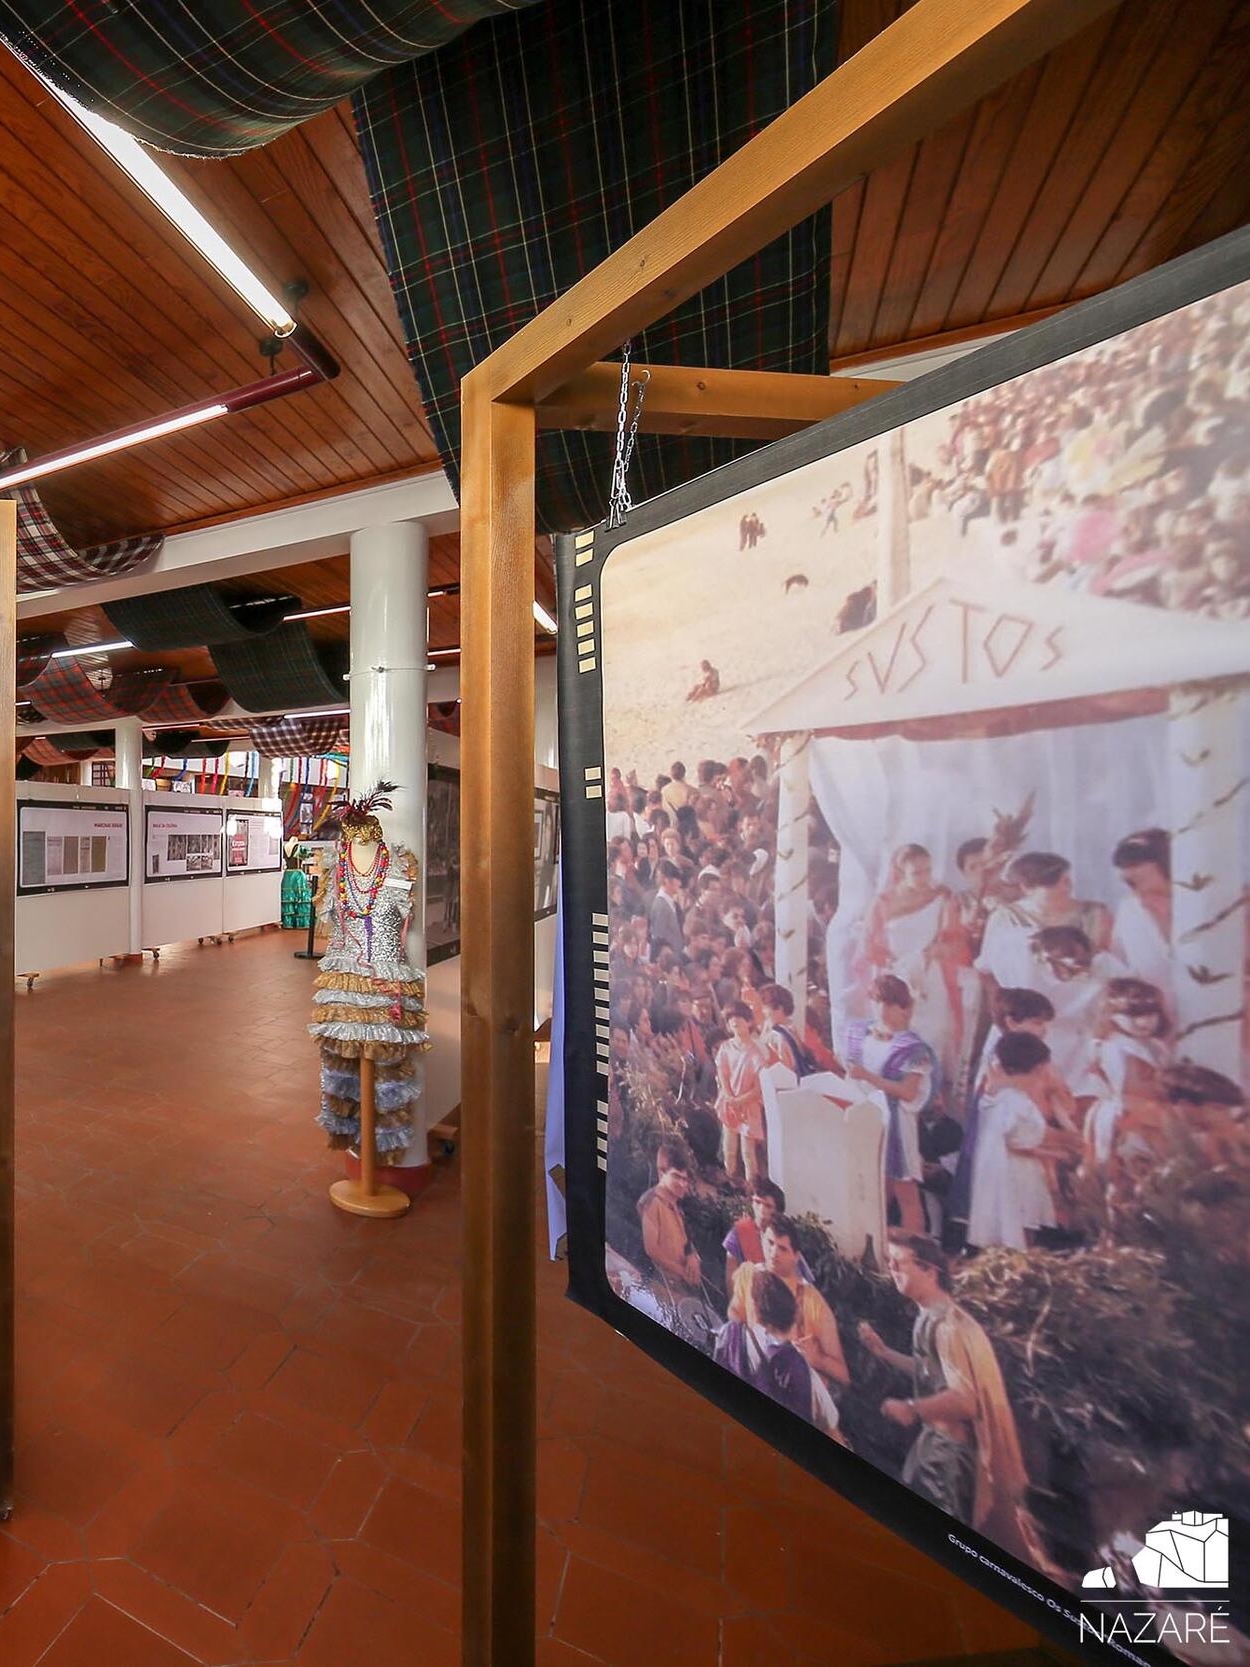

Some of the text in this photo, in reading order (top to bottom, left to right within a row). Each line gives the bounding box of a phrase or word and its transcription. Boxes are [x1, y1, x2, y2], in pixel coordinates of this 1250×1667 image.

[948, 1534, 978, 1558] Grupo
[979, 1555, 1044, 1602] carnavalesco
[1046, 1598, 1062, 1612] Os
